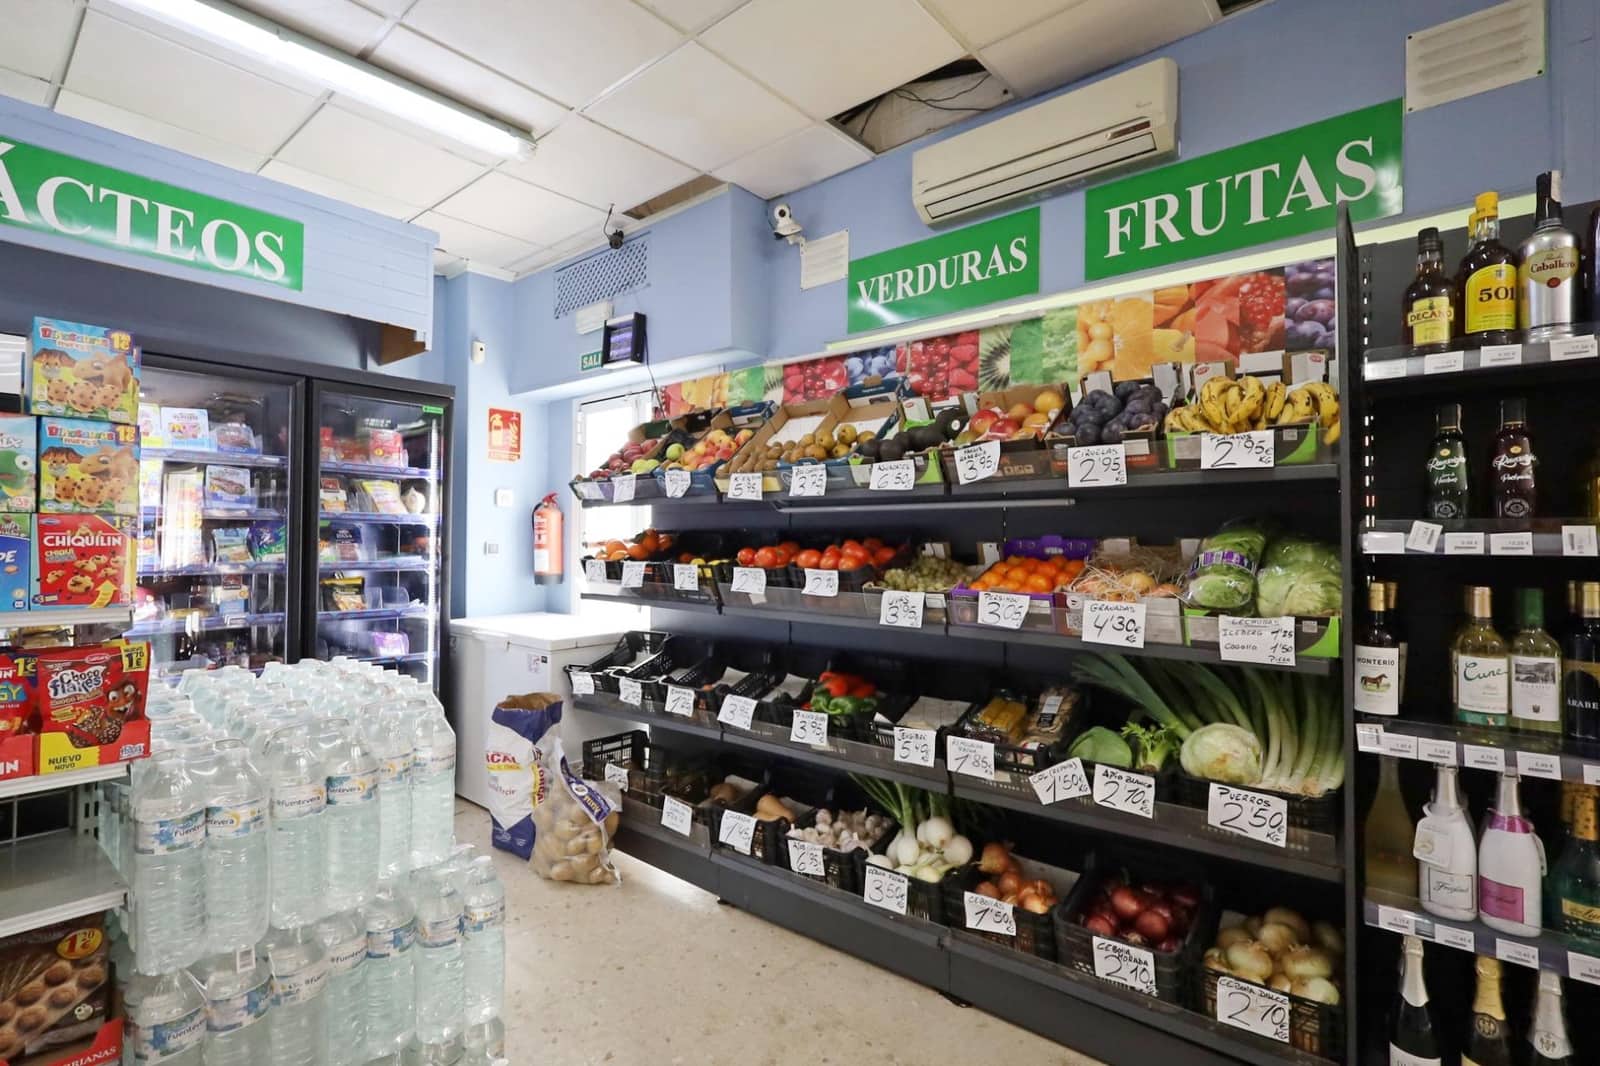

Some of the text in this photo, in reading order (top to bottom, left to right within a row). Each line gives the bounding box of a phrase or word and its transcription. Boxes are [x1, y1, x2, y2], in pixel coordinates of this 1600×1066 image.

[1103, 137, 1377, 259] FRUTAS
[856, 235, 1029, 306] VERDURAS
[48, 754, 82, 766] NUEVO
[1218, 787, 1272, 808] PUERROS
